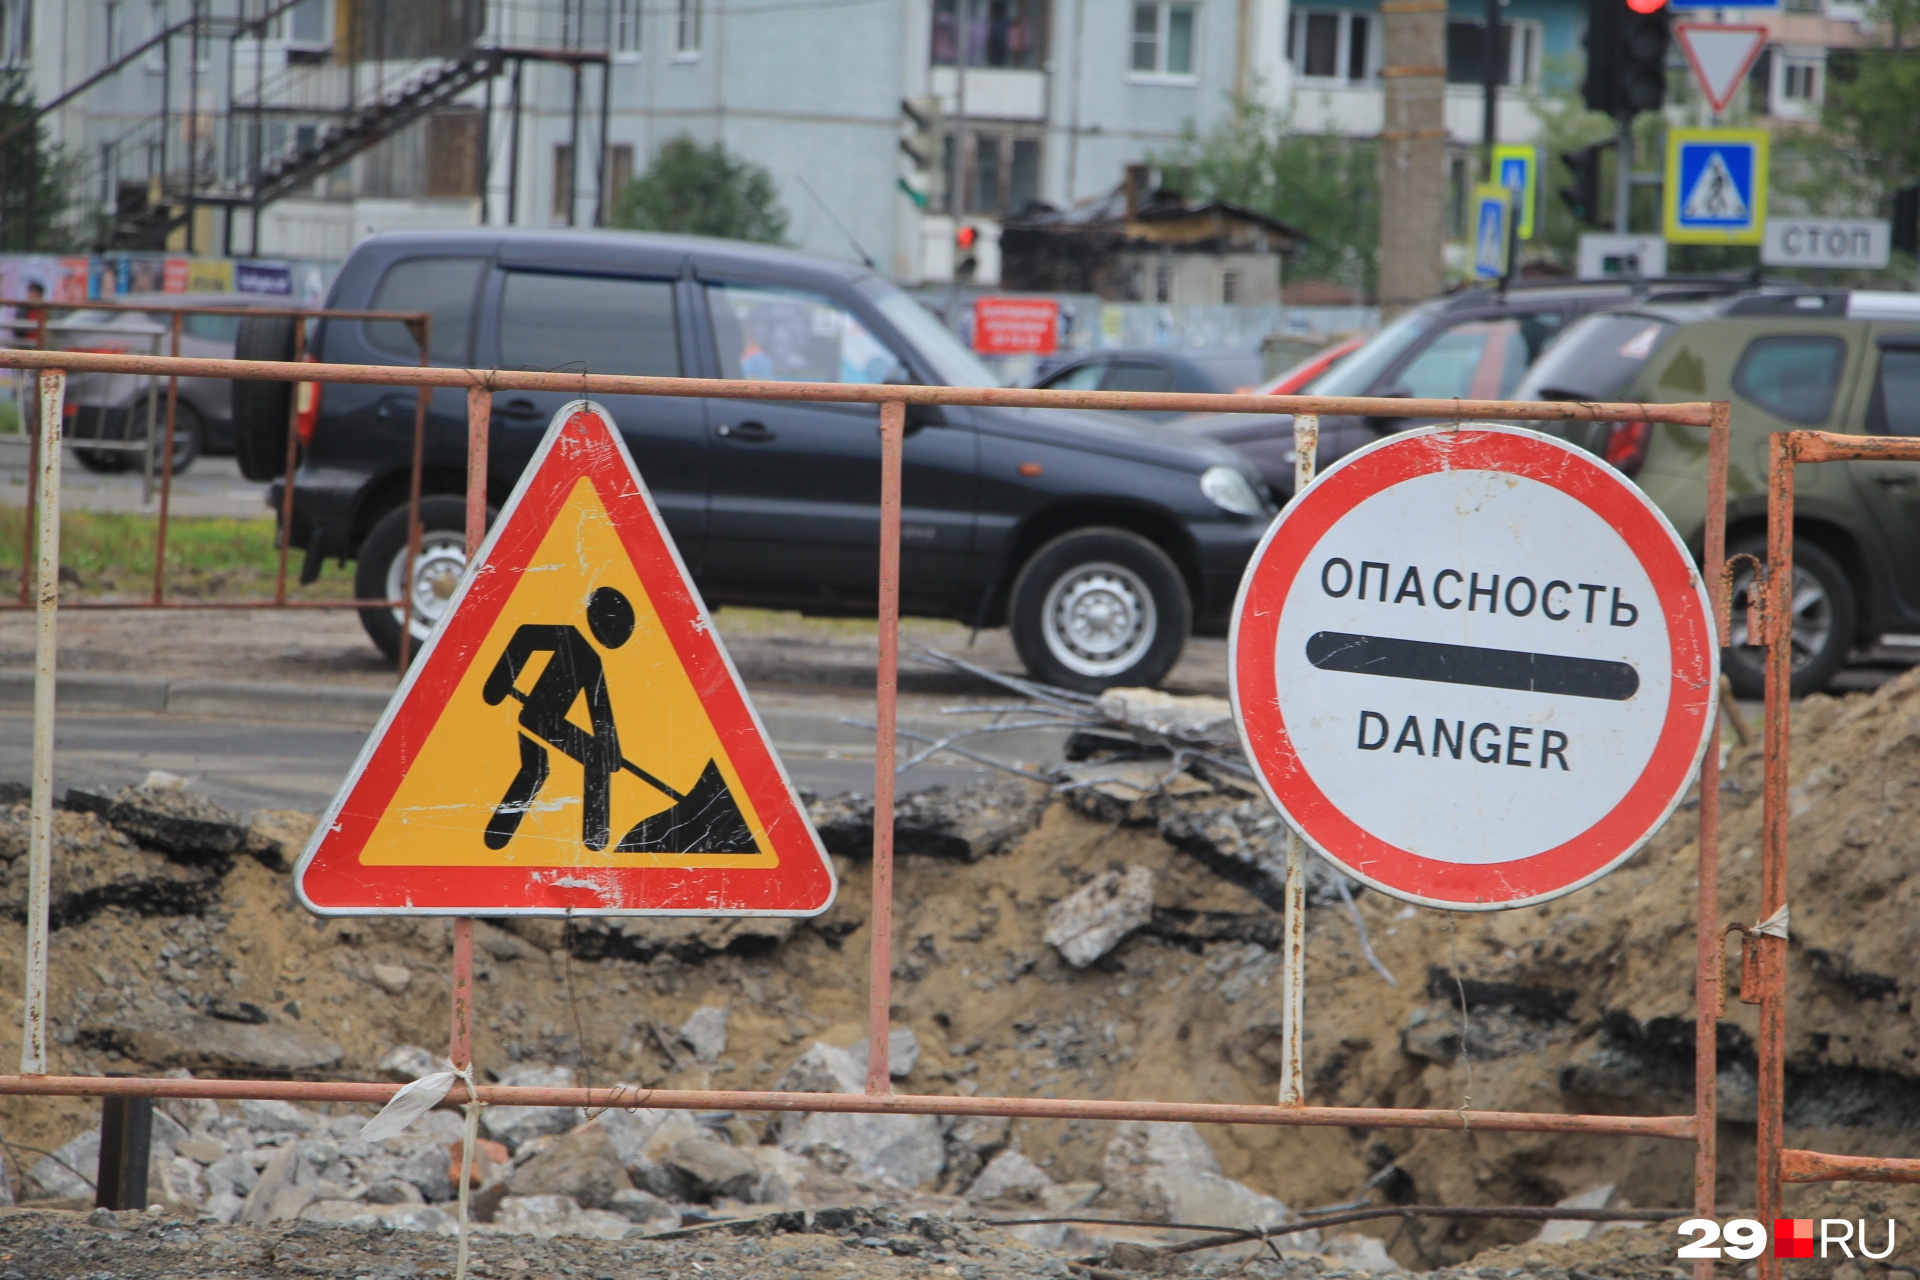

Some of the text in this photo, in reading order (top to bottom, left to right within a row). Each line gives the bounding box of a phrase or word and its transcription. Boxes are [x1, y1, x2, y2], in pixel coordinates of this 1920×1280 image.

[1781, 225, 1871, 257] СТОП
[1321, 557, 1638, 627] ОПАСНОСТЬ
[1358, 711, 1570, 771] DANGER
